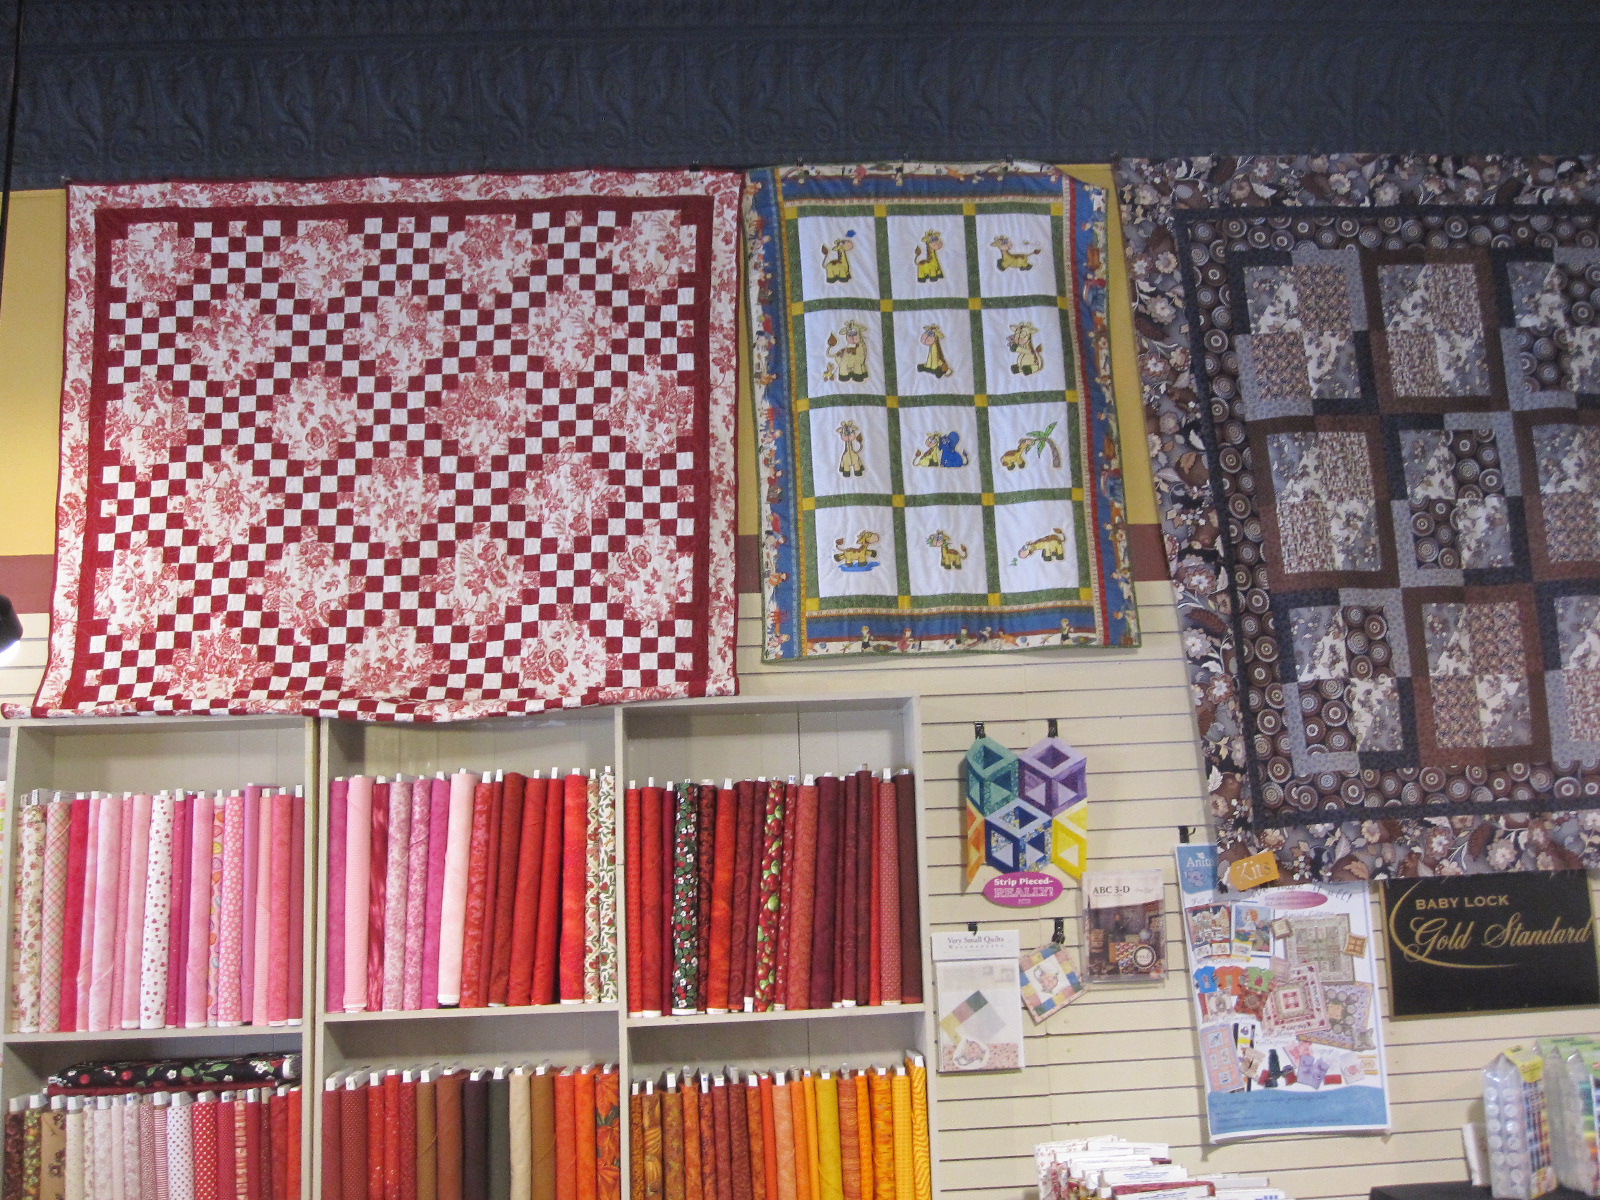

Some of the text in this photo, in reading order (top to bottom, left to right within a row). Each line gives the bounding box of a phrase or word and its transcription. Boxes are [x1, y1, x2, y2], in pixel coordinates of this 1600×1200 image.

[1239, 860, 1271, 881] Kits
[994, 878, 1017, 887] Strip
[1092, 886, 1112, 895] ABC
[1115, 885, 1131, 894] 3-D
[1416, 895, 1511, 911] BABY LOCK
[947, 937, 962, 945] Very
[1404, 911, 1594, 962] Gold Standard
